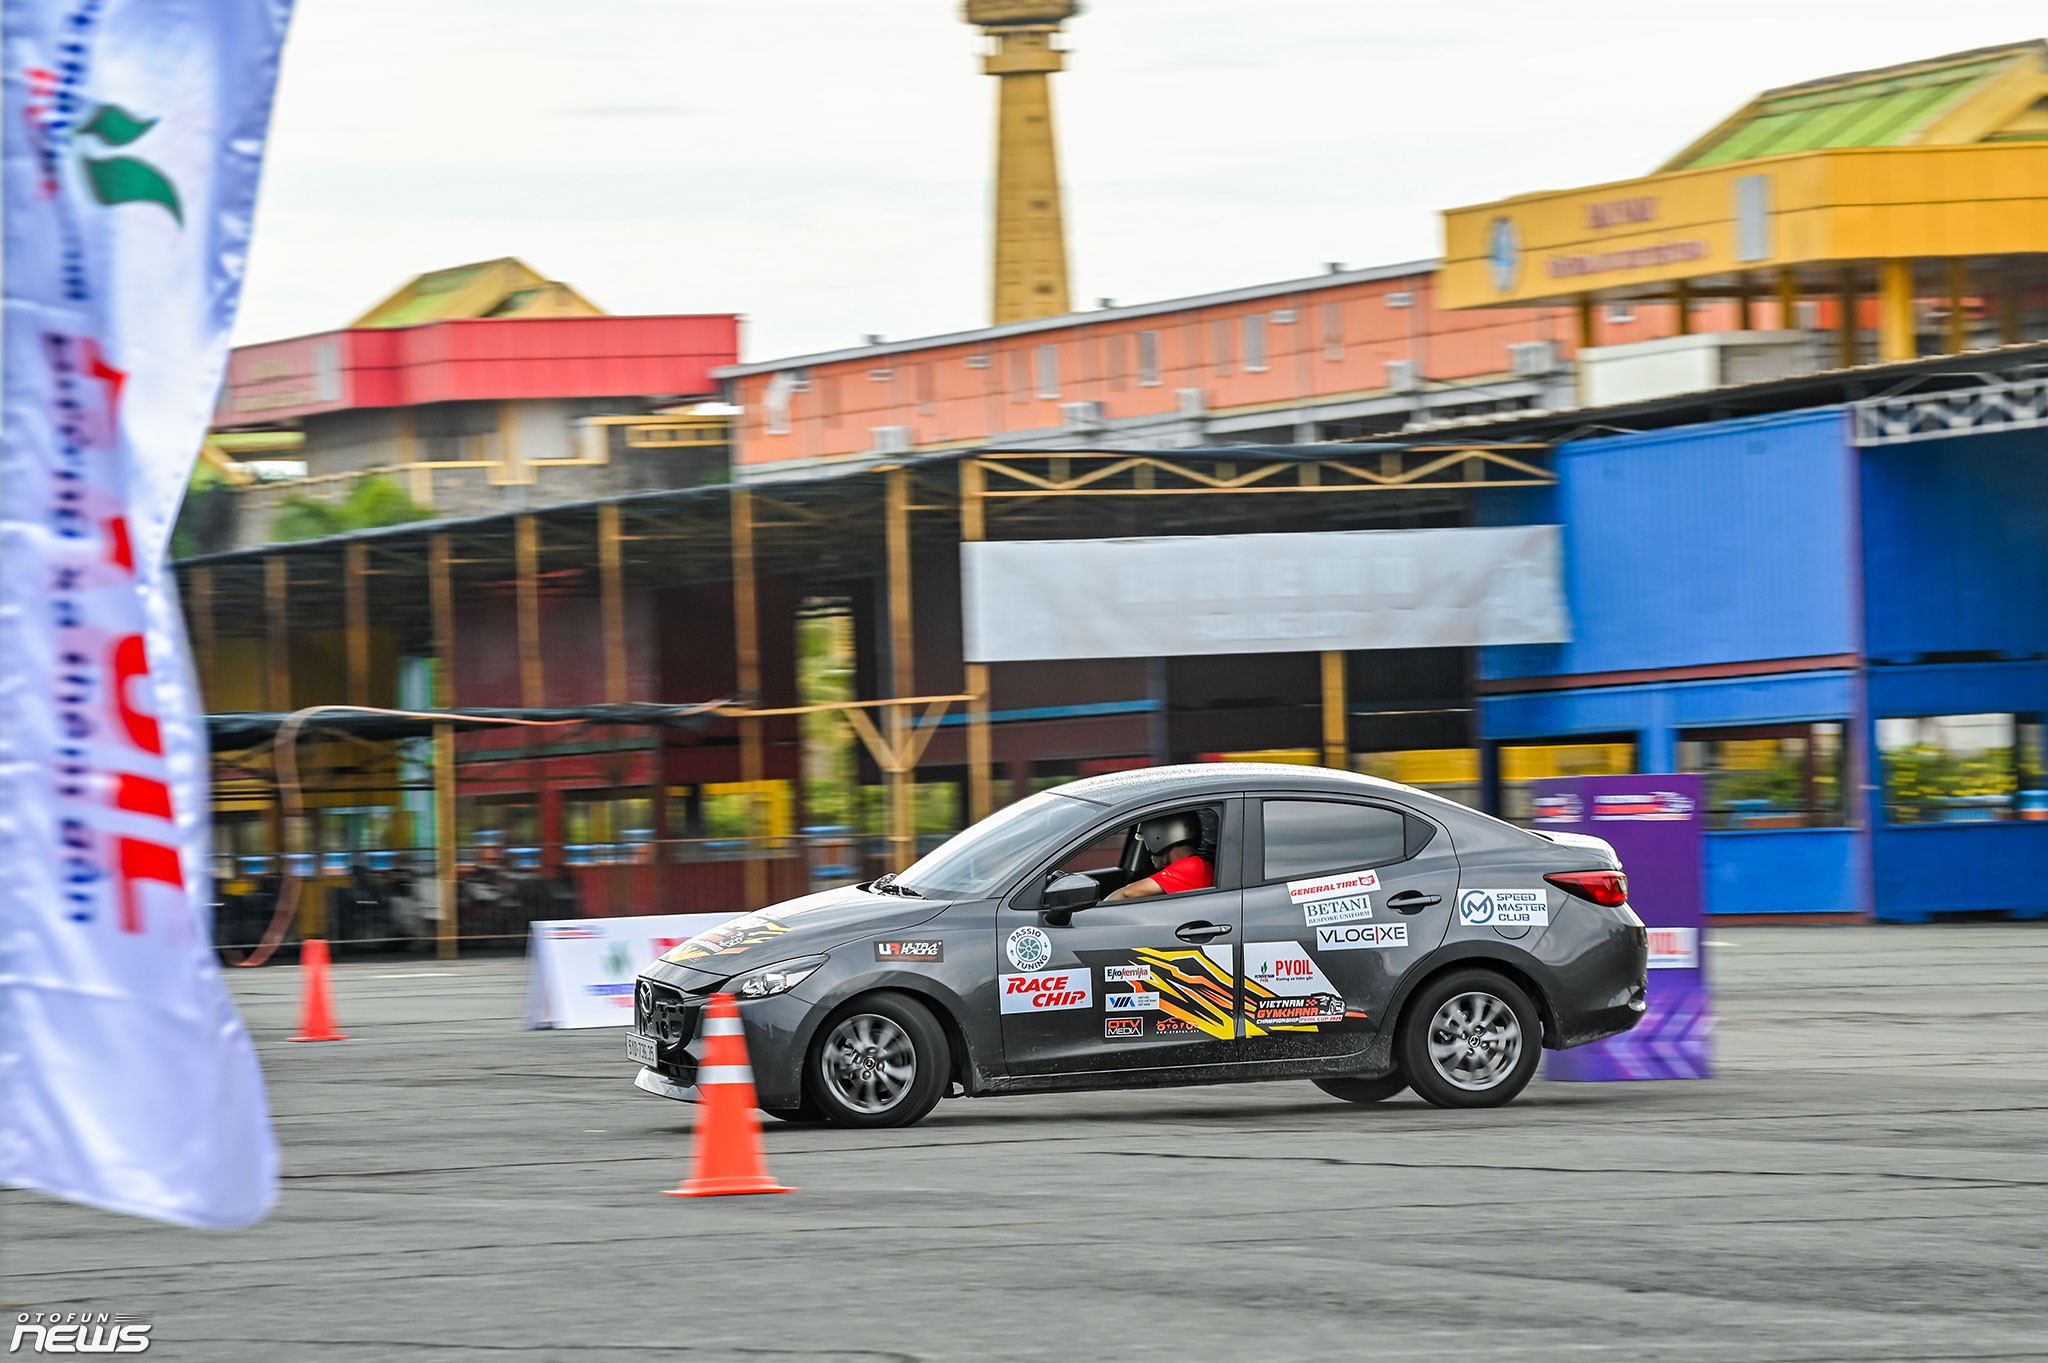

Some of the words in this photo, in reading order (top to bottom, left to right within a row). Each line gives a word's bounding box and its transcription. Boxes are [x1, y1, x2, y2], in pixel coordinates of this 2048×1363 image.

[1290, 884, 1335, 897] GENERAL
[1335, 879, 1358, 889] TIRE
[1496, 893, 1537, 901] SPEED
[1306, 897, 1370, 917] BETANI
[1497, 903, 1546, 912] MASTER
[1308, 915, 1340, 924] BESPOKE
[1340, 910, 1370, 920] UNIFORM
[1498, 913, 1530, 921] CLUB
[1010, 928, 1042, 942] PASSIO
[902, 942, 938, 950] ULTRA
[1016, 954, 1048, 970] TUNING
[1275, 959, 1314, 976] PVOIL
[1006, 976, 1069, 994] RACE
[1032, 991, 1086, 1007] CHIP
[1259, 999, 1305, 1009] VIETNAM
[1257, 1007, 1319, 1019] GYMKHANA
[1107, 1020, 1141, 1029] OTV
[1107, 1027, 1141, 1036] MEDIA
